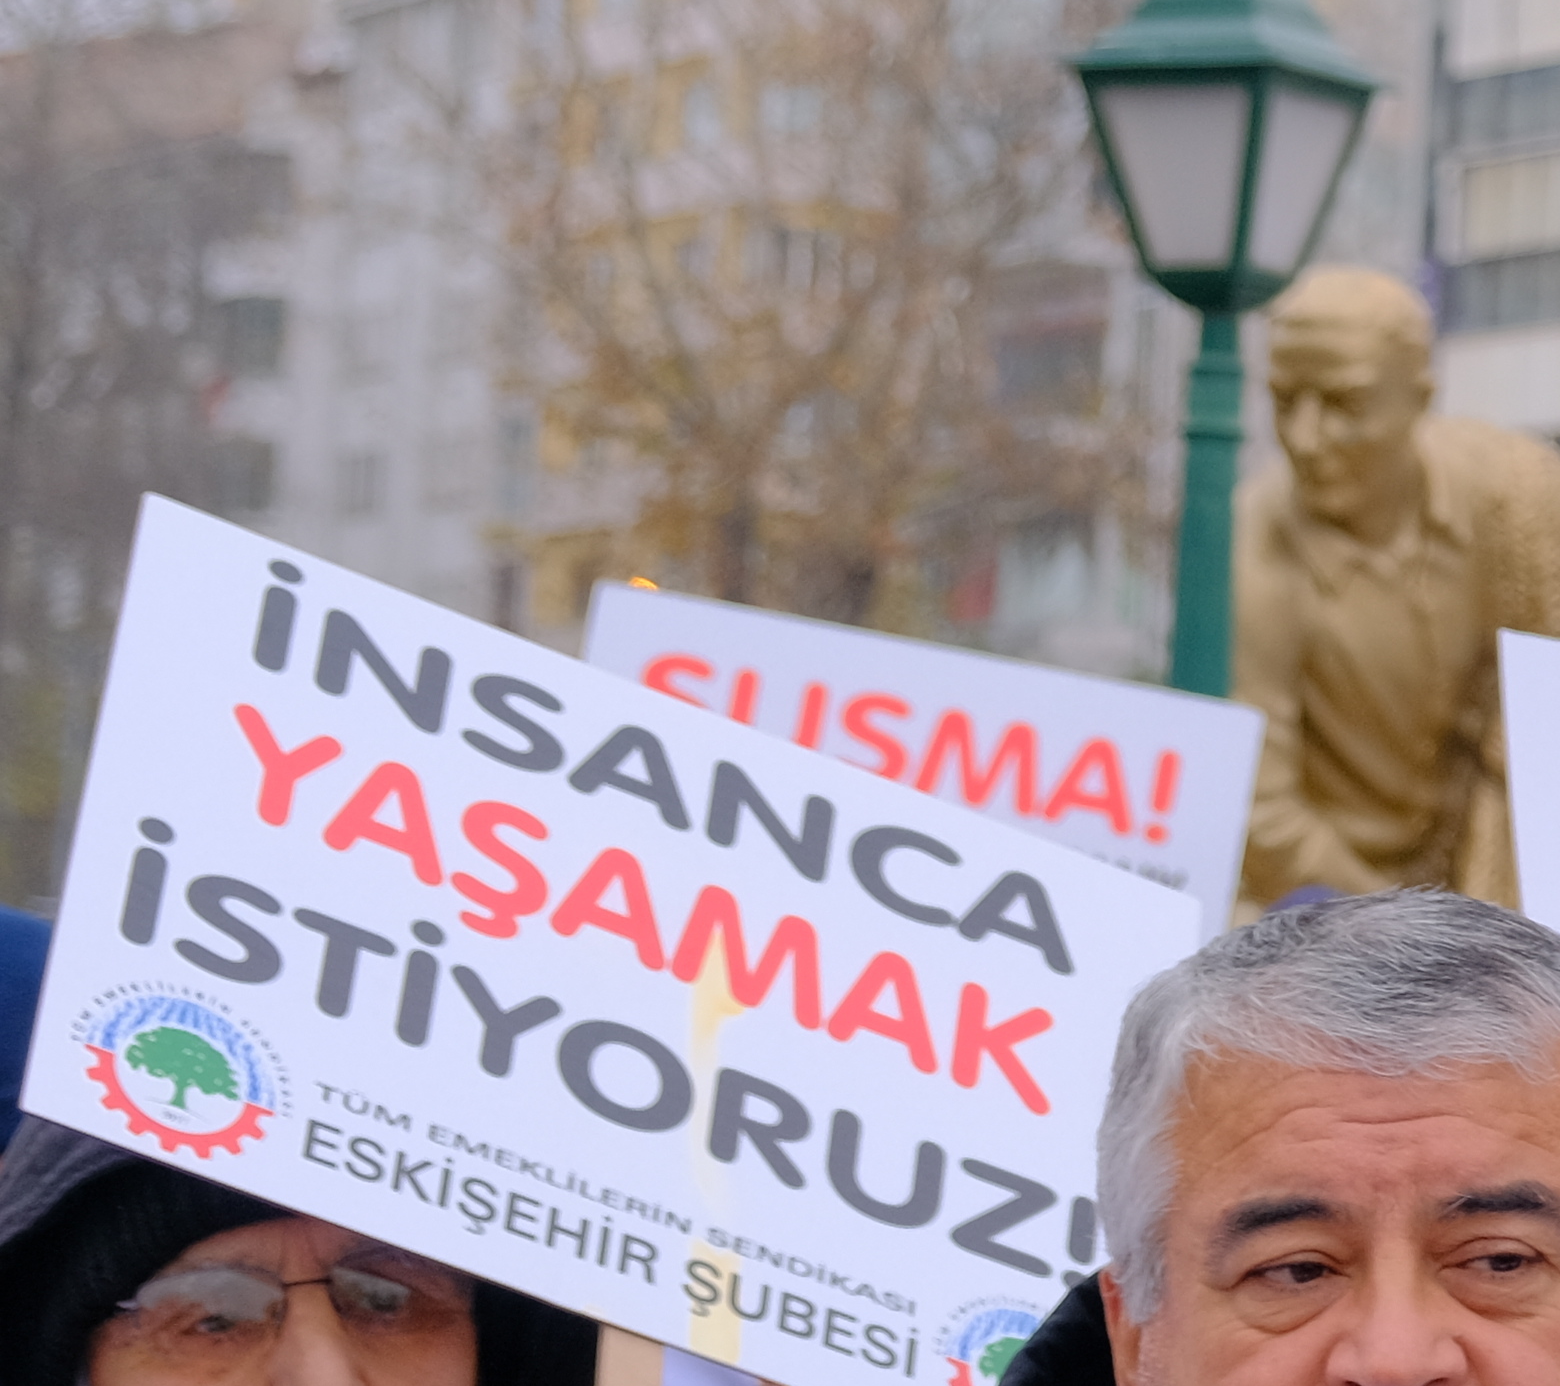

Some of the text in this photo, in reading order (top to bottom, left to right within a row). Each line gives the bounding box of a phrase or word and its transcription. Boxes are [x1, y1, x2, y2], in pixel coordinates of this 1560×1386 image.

[233, 703, 1053, 1116] YAŞAMAK
[252, 559, 1075, 975] İNSANCA
[118, 816, 1100, 1288] İSTİYORUZ!
[302, 1117, 659, 1284] ESKİŞEHİR
[682, 1258, 919, 1379] ŞUBESİ
[314, 1081, 918, 1318] TÜM EMEKLİLERİN SENDİKASI
